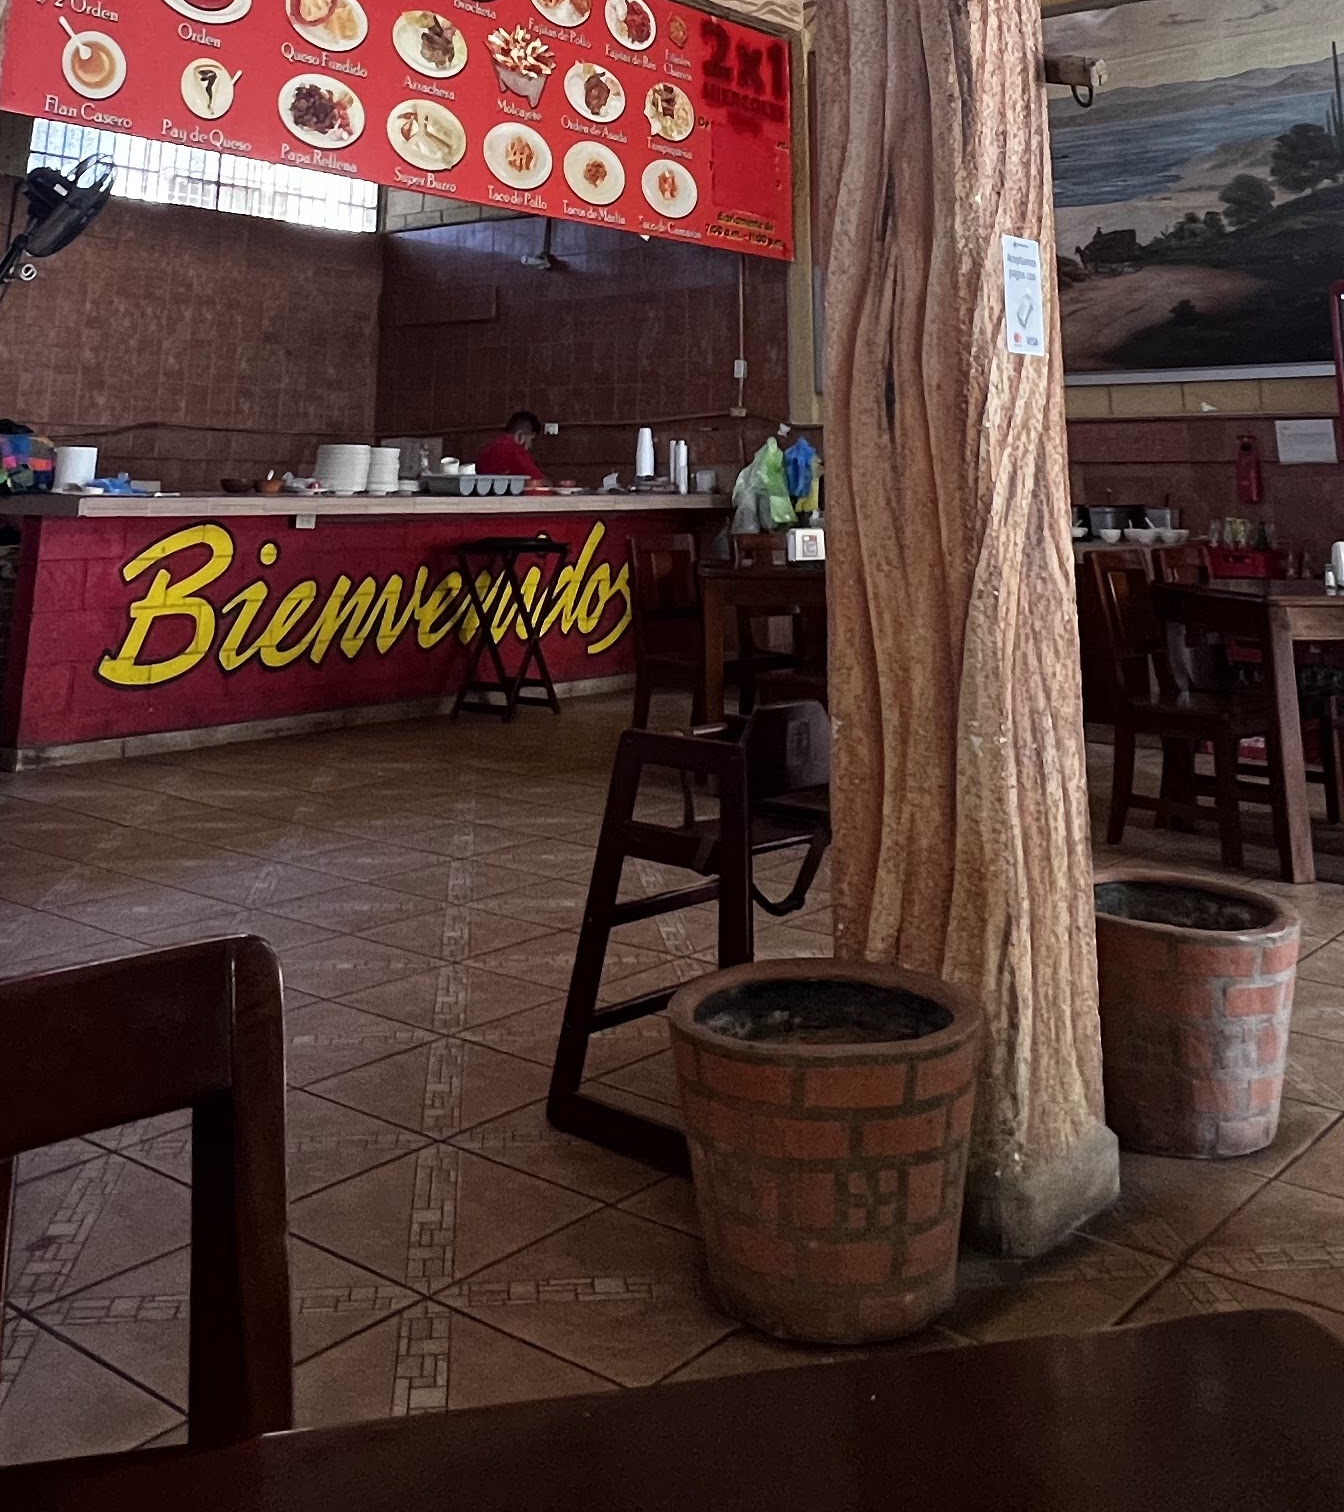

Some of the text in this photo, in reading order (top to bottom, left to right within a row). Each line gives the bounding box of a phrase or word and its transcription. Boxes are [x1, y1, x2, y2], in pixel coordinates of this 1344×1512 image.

[177, 22, 222, 49] Orden
[281, 41, 368, 78] Queso Fundido
[44, 94, 134, 129] Flan Casero
[161, 118, 253, 152] Pay de Queso
[281, 143, 358, 173] Papa Rellena
[394, 166, 457, 193] Super Burro
[487, 185, 511, 204] Taco
[523, 191, 548, 210] Pollo
[97, 517, 636, 688] Bienvenidos
